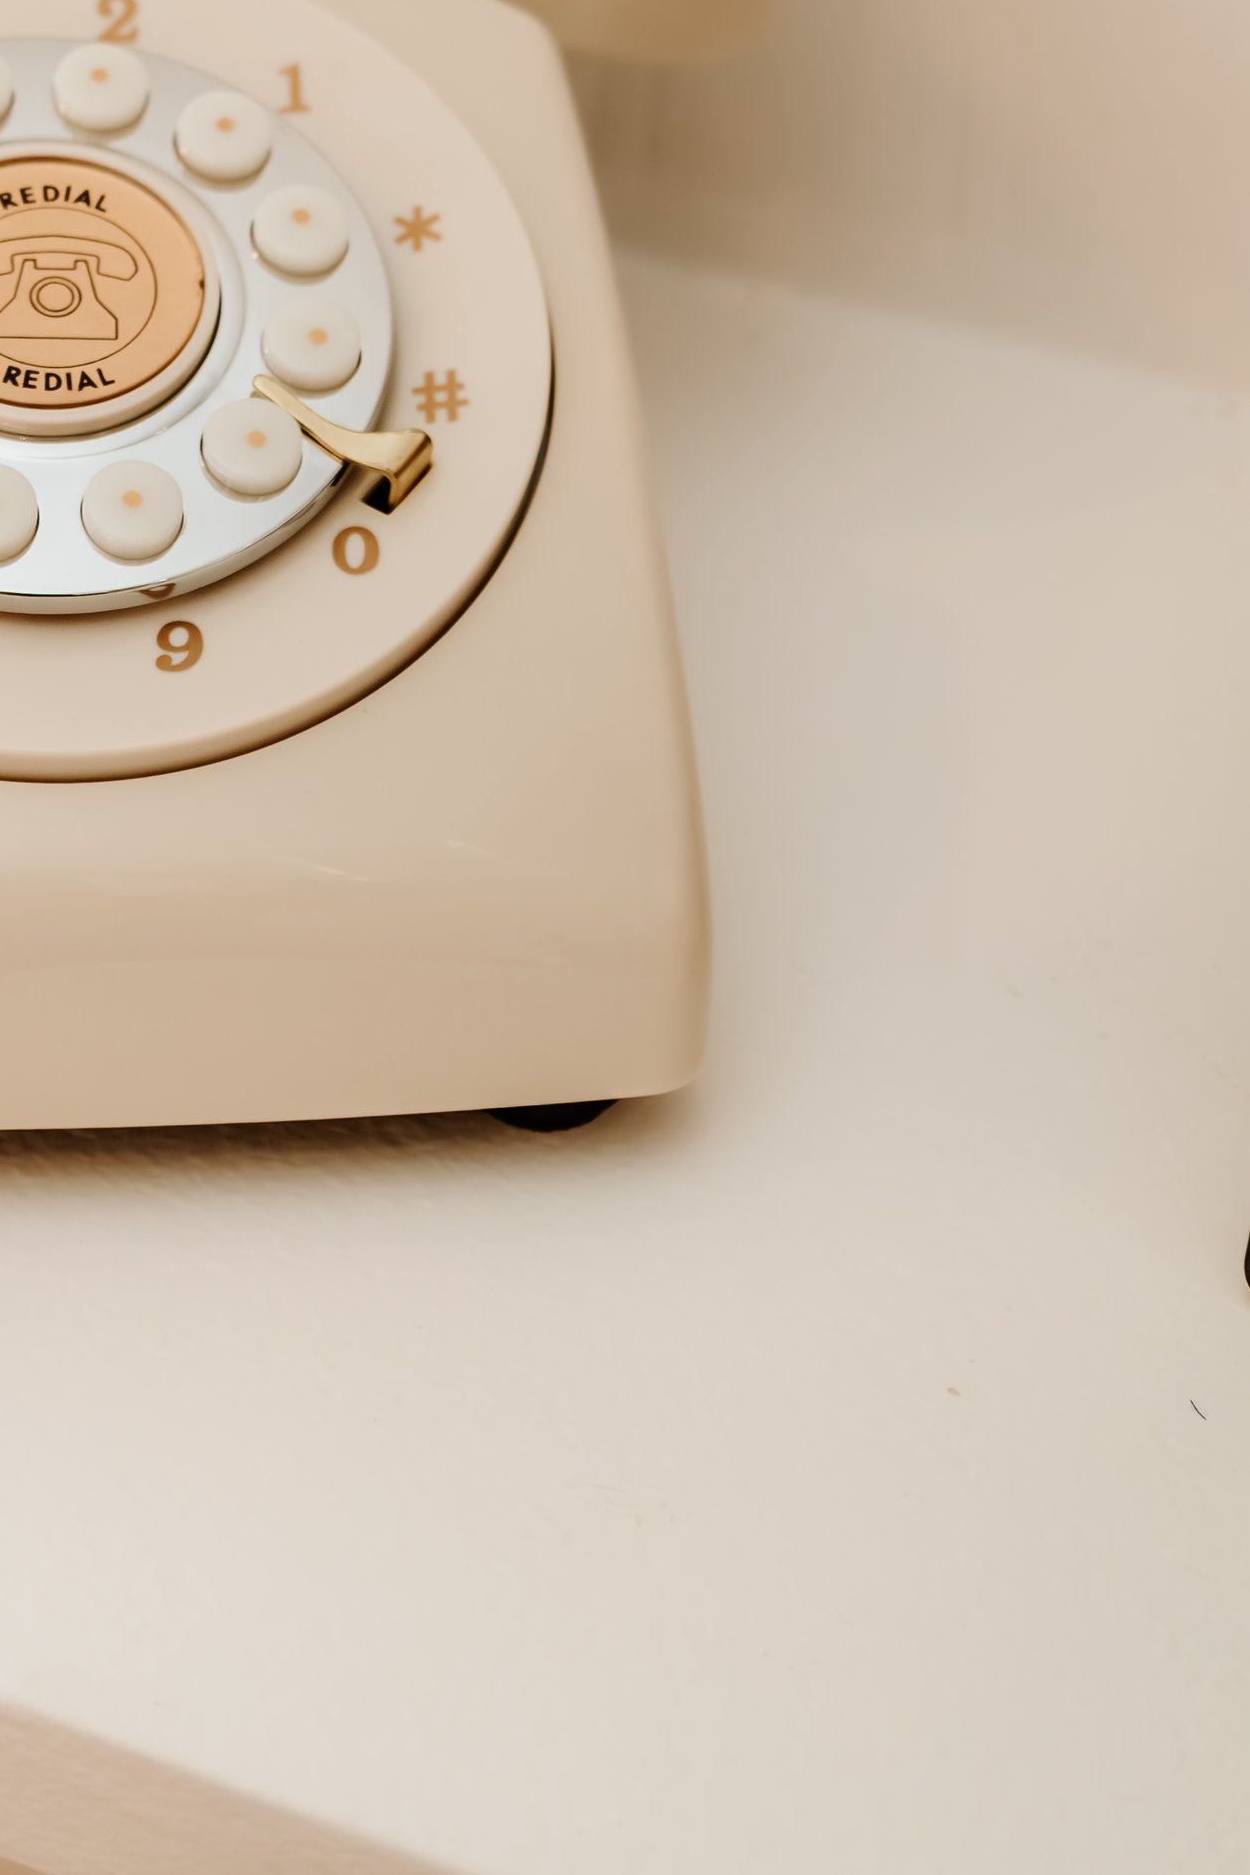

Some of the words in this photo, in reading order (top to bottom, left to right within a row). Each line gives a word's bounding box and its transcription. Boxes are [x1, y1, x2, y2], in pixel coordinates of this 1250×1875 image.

[278, 62, 310, 115] 1
[3, 366, 115, 392] REDIAL
[332, 526, 380, 575] 0
[155, 621, 203, 672] 9
